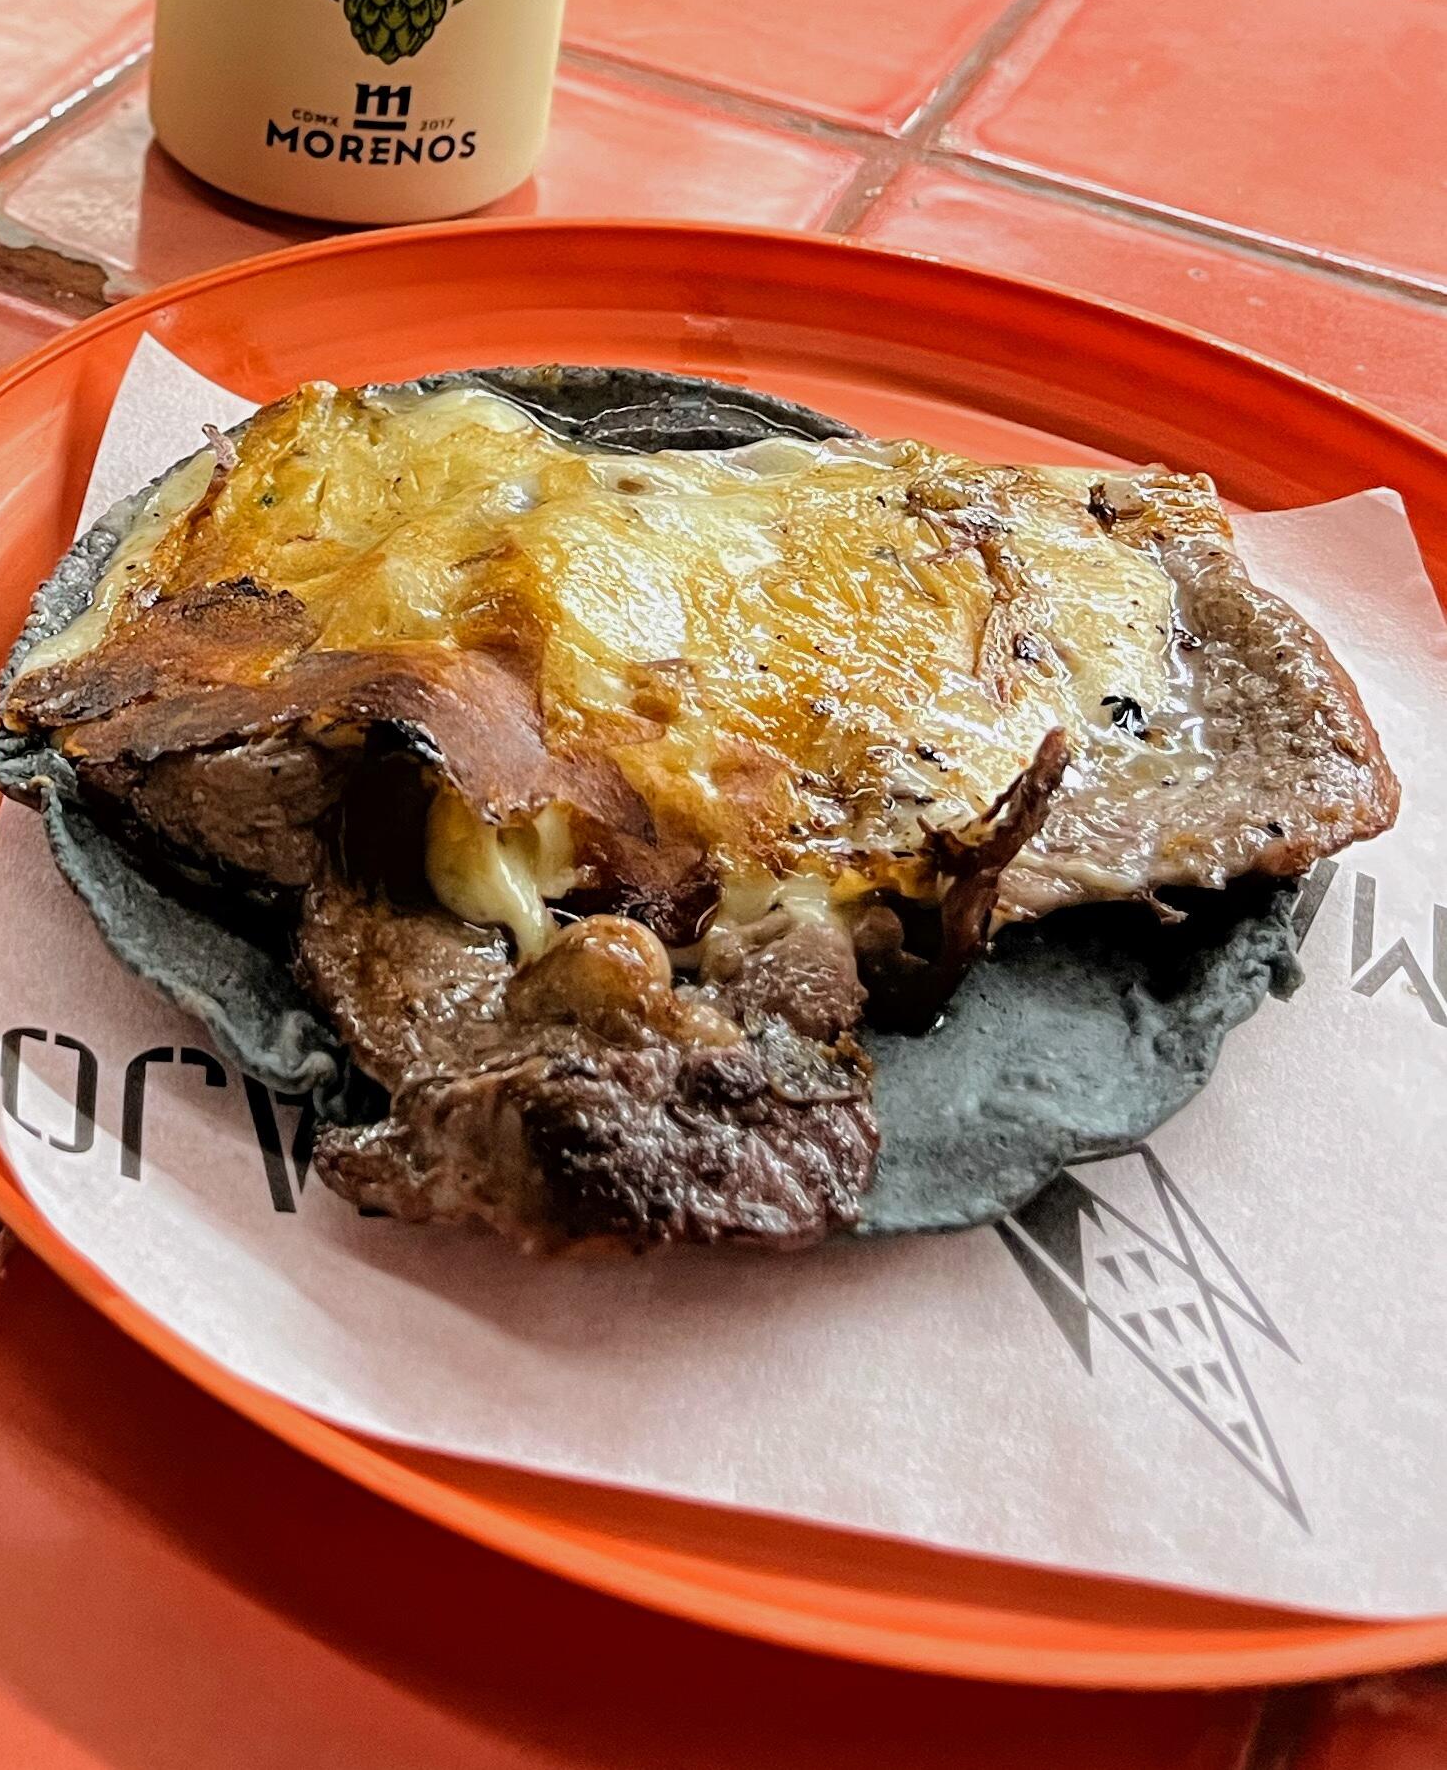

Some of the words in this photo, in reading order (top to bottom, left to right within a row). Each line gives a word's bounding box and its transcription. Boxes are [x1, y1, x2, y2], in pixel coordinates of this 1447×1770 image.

[291, 107, 339, 128] CDMX
[419, 116, 456, 133] 2017
[266, 118, 477, 166] MORENOS
